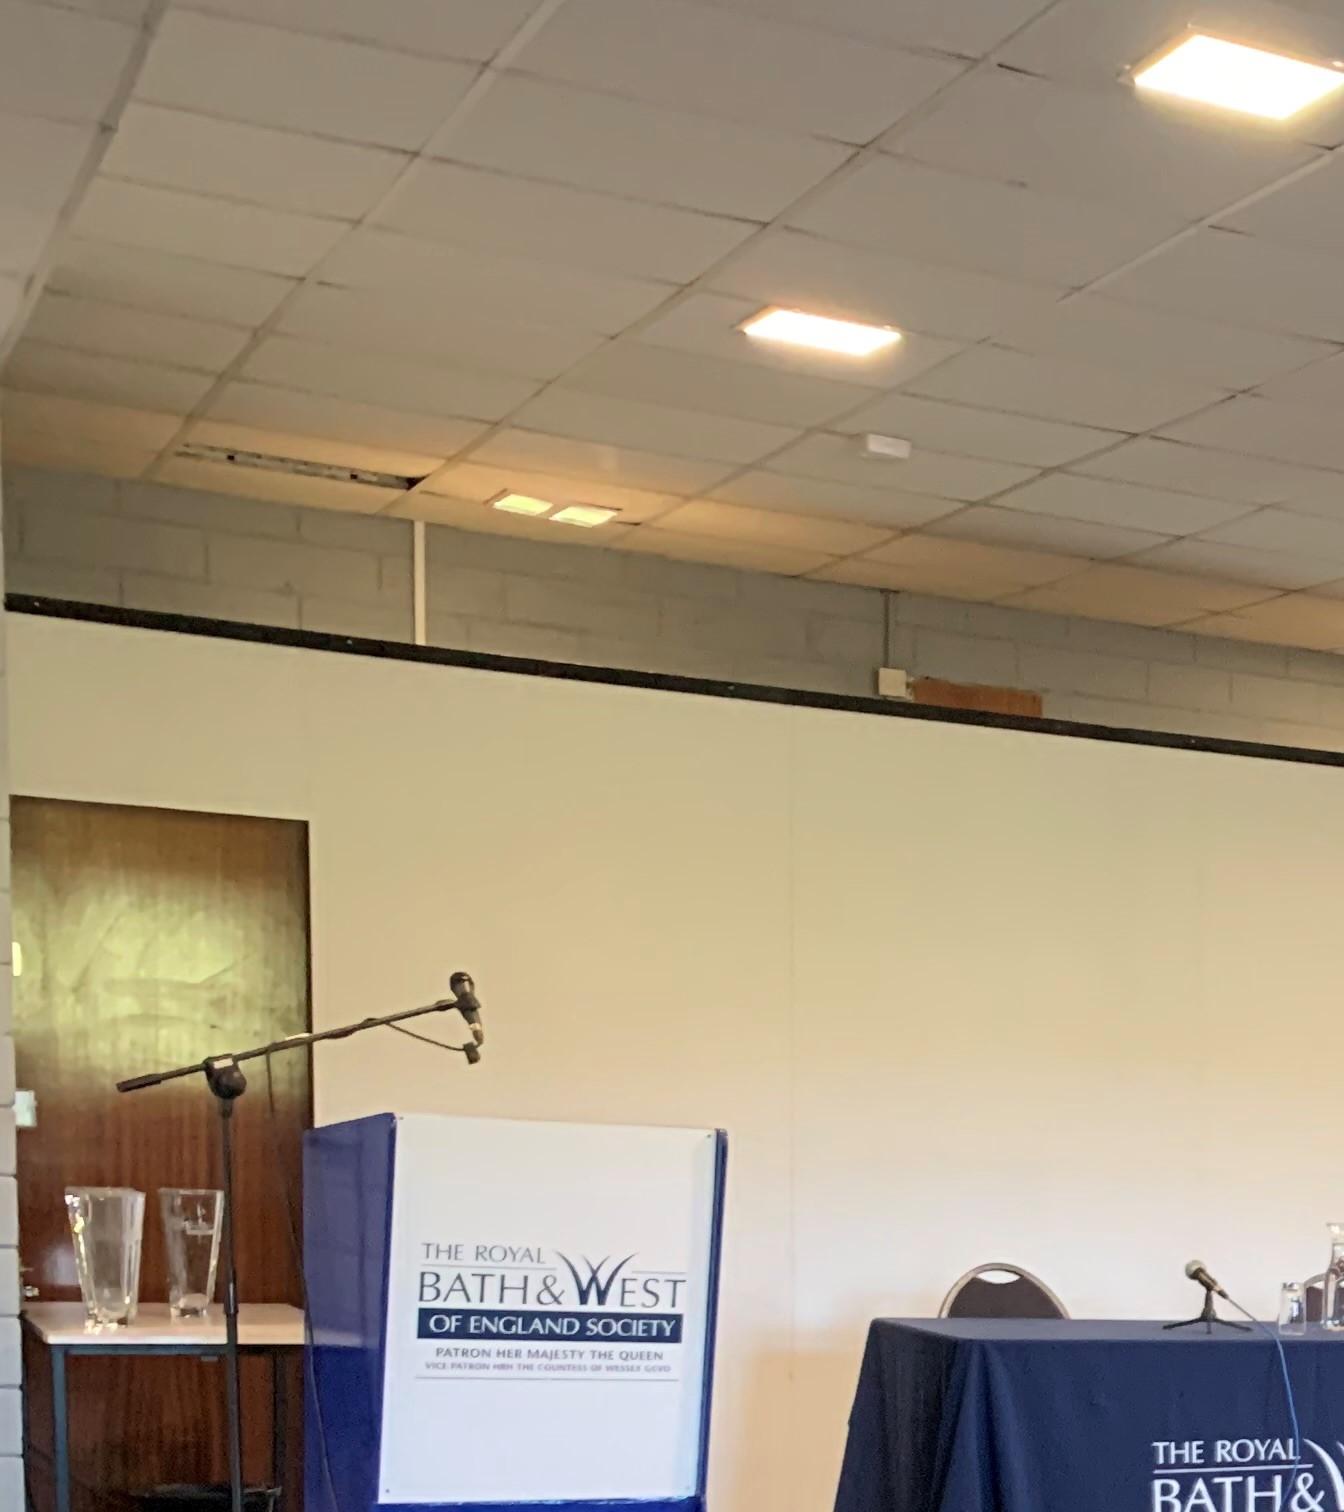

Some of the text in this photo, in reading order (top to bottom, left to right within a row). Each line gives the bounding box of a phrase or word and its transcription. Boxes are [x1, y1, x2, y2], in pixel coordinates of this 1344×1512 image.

[421, 1242, 546, 1264] THE ROYAL
[429, 1314, 676, 1338] OF ENGLAND SOCIETY
[436, 1347, 663, 1361] PATRON HER MAJESTY THE QUEEN
[1152, 1437, 1301, 1465] THE ROYAL
